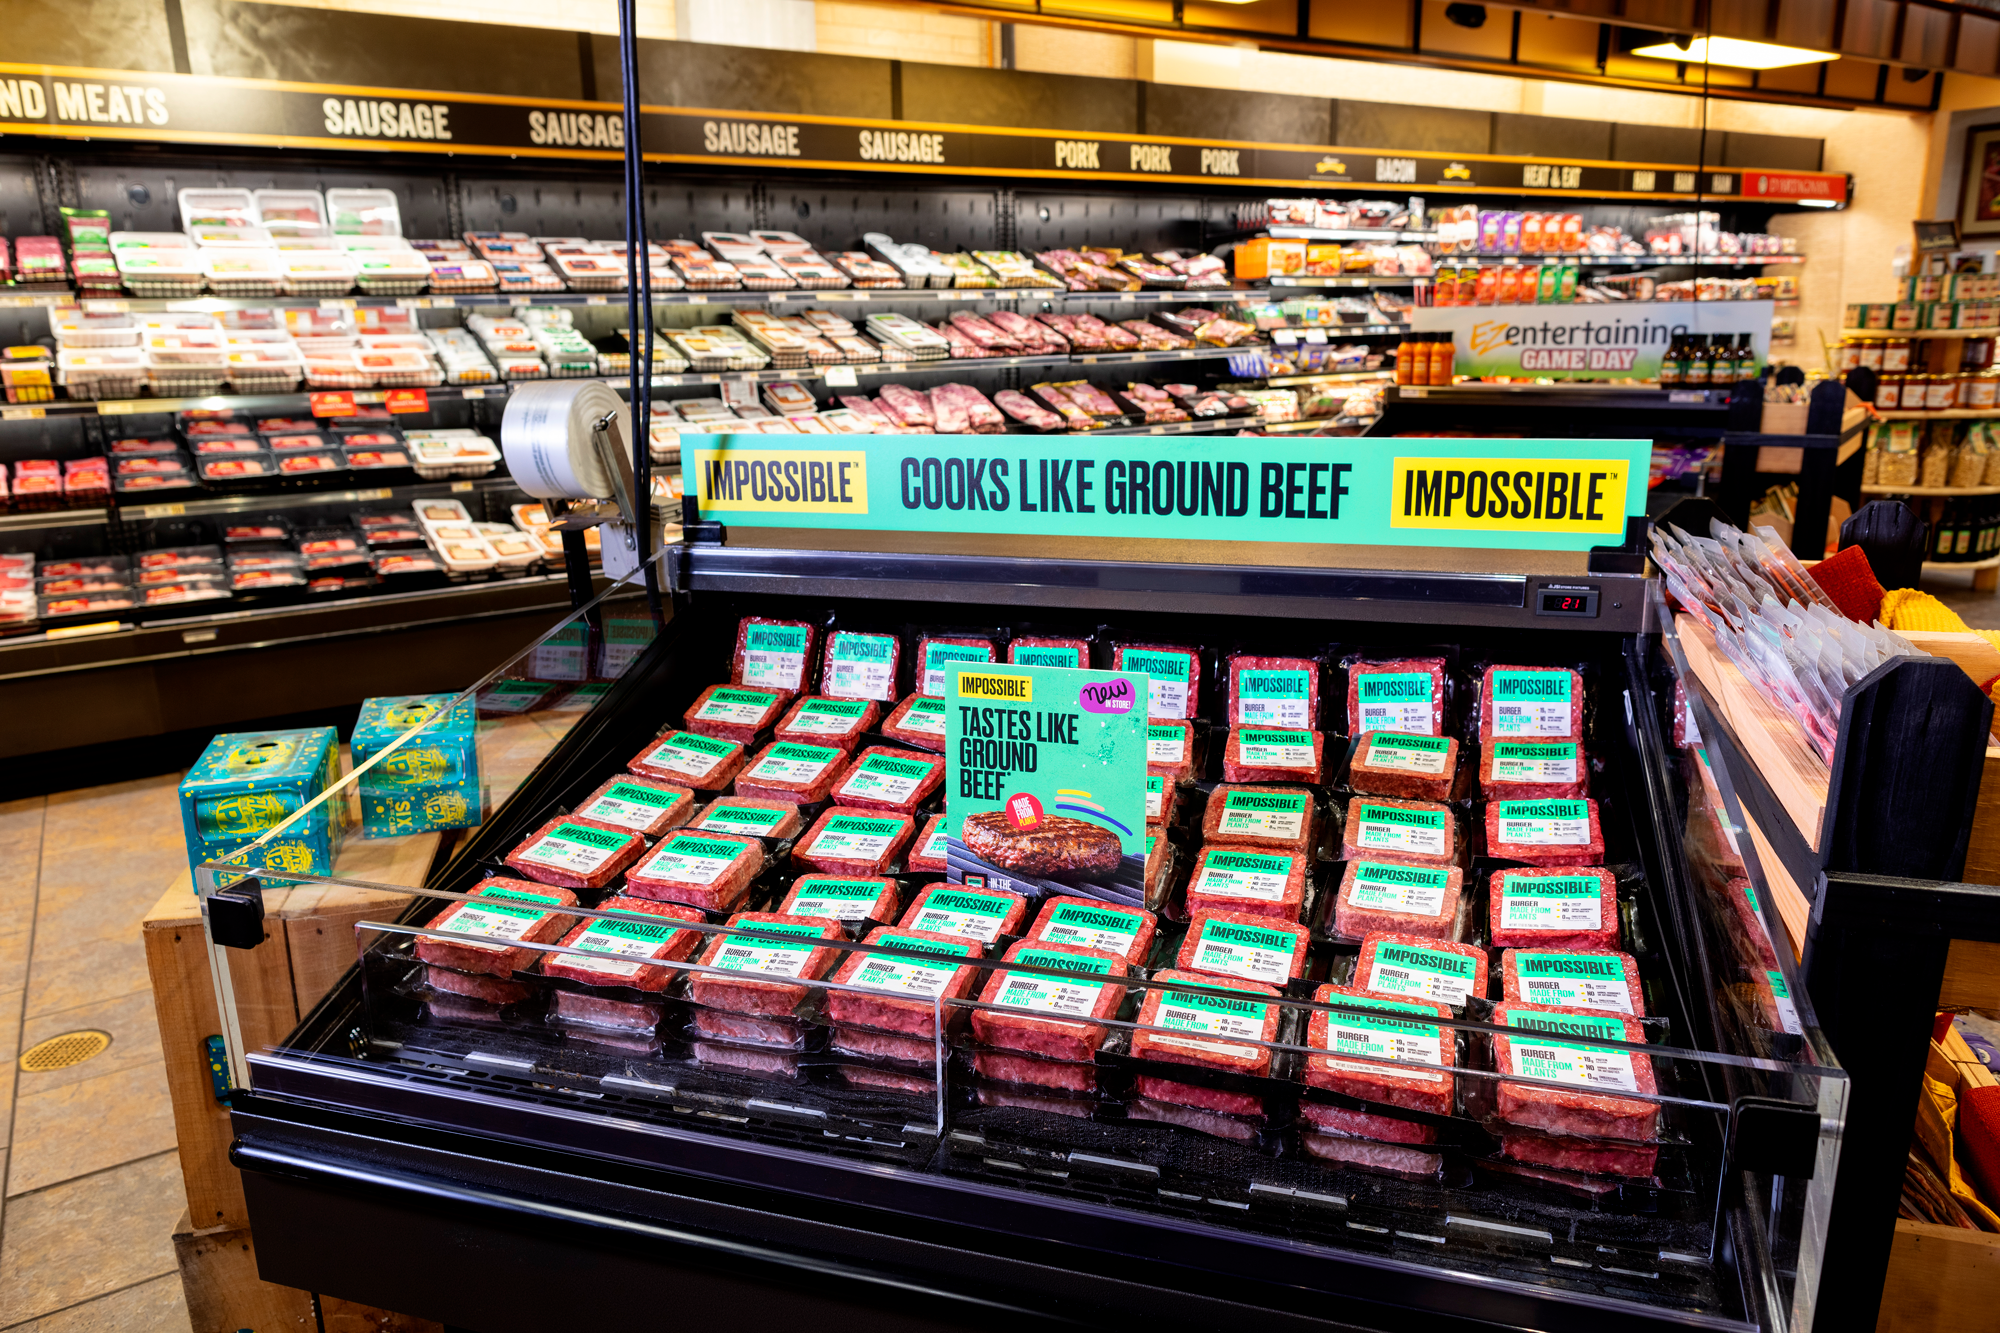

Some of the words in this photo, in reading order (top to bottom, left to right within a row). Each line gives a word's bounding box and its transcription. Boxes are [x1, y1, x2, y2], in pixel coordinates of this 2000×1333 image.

[53, 82, 169, 126] MEATS
[323, 97, 452, 140] SAUSAGE
[528, 110, 625, 148] SAUSAG
[703, 121, 800, 157] SAUSAGE
[859, 130, 945, 164] SAUSAGE
[1055, 139, 1100, 169] PORK
[1130, 144, 1171, 172] PORK
[1200, 148, 1239, 176] PORK
[1375, 157, 1417, 183] BACON
[1523, 164, 1548, 188] HEAT
[1562, 166, 1582, 189] EAT
[1521, 349, 1586, 371] GAME
[1588, 349, 1637, 371] DAY
[900, 456, 1009, 512] COOKS
[1020, 459, 1095, 514] LIKE
[1104, 459, 1248, 518] GROUND
[1260, 462, 1353, 520] BEEF
[1561, 597, 1580, 609] 21
[752, 632, 801, 647] IMPOSSIBLE
[839, 641, 887, 658] IMPOSSIBLE
[1128, 656, 1184, 676] IMPOSSIBLE
[962, 676, 1027, 698] IMPOSSIBLE
[1245, 678, 1303, 693] IMPOSSIBLE
[1365, 681, 1425, 696] IMPOSSIBLE
[1500, 679, 1564, 695] IMPOSSIBLE
[1112, 700, 1131, 709] STORE!
[1499, 707, 1521, 715] BURGER
[959, 706, 1031, 740] TASTES
[1037, 711, 1079, 745] LIKE
[1499, 724, 1520, 732] PLANTS
[1246, 734, 1306, 743] IMPOSSIBLE
[1378, 737, 1442, 749] IMPOSSIBLE
[775, 747, 831, 760] IMPOSSIBLE
[959, 738, 1037, 773] GROUND
[1501, 747, 1569, 756] IMPOSSIBLE
[868, 759, 925, 775] IMPOSSIBLE
[613, 786, 672, 805] IMPOSSIBLE
[1232, 797, 1299, 808] IMPOSSIBLE
[1012, 797, 1030, 810] MADE
[1507, 805, 1580, 816] IMPOSSIBLE
[218, 797, 248, 832] IPA
[249, 797, 267, 830] HAZY
[395, 800, 413, 829] SIX
[716, 810, 777, 822] IMPOSSIBLE
[1016, 806, 1034, 819] FROM
[1367, 809, 1437, 825] IMPOSSIBLE
[389, 816, 397, 835] CANS
[832, 820, 896, 833] IMPOSSIBLE
[1018, 816, 1037, 827] PLANTS
[558, 828, 622, 847] IMPOSSIBLE
[672, 841, 738, 856] IMPOSSIBLE
[1213, 855, 1284, 871] IMPOSSIBLE
[1364, 868, 1440, 884] IMPOSSIBLE
[806, 884, 877, 896] IMPOSSIBLE
[990, 877, 998, 889] IN
[999, 878, 1011, 891] THE
[1512, 882, 1592, 894] IMPOSSIBLE
[933, 894, 1005, 913] IMPOSSIBLE
[1059, 909, 1134, 930] IMPOSSIBLE
[1210, 925, 1288, 948] IMPOSSIBLE
[725, 948, 753, 957] BURGER
[1203, 950, 1223, 960] MADE
[1223, 954, 1243, 962] FROM
[1205, 944, 1233, 954] BURGER
[717, 962, 744, 971] PLANTS
[721, 955, 740, 963] MADE
[739, 957, 760, 965] FROM
[867, 962, 895, 972] BURGER
[1201, 957, 1228, 966] PLANTS
[1383, 948, 1468, 973] IMPOSSIBLE
[862, 969, 882, 977] MADE
[882, 971, 903, 980] FROM
[1380, 968, 1409, 979] BURGER
[1525, 960, 1616, 975] IMPOSSIBLE
[858, 974, 886, 984] PLANTS
[1009, 981, 1038, 991] BURGER
[1377, 980, 1405, 992] PLANTS
[1378, 975, 1400, 985] MADE
[1400, 978, 1421, 988] FROM
[1528, 981, 1559, 989] BURGER
[1006, 988, 1026, 997] MADE
[1027, 991, 1048, 999] FROM
[1001, 996, 1030, 1006] PLANTS
[1530, 997, 1561, 1005] PLANTS
[1166, 1010, 1197, 1021] BURGER
[1163, 1017, 1184, 1027] MADE
[1186, 1020, 1208, 1030] FROM
[1337, 1031, 1369, 1042] BURGER
[1337, 1039, 1359, 1049] MADE
[1361, 1042, 1384, 1053] FROM
[1521, 1049, 1555, 1060] BURGER
[1522, 1057, 1545, 1068] MADE
[1548, 1061, 1572, 1071] FROM
[1523, 1066, 1557, 1078] PLANTS
